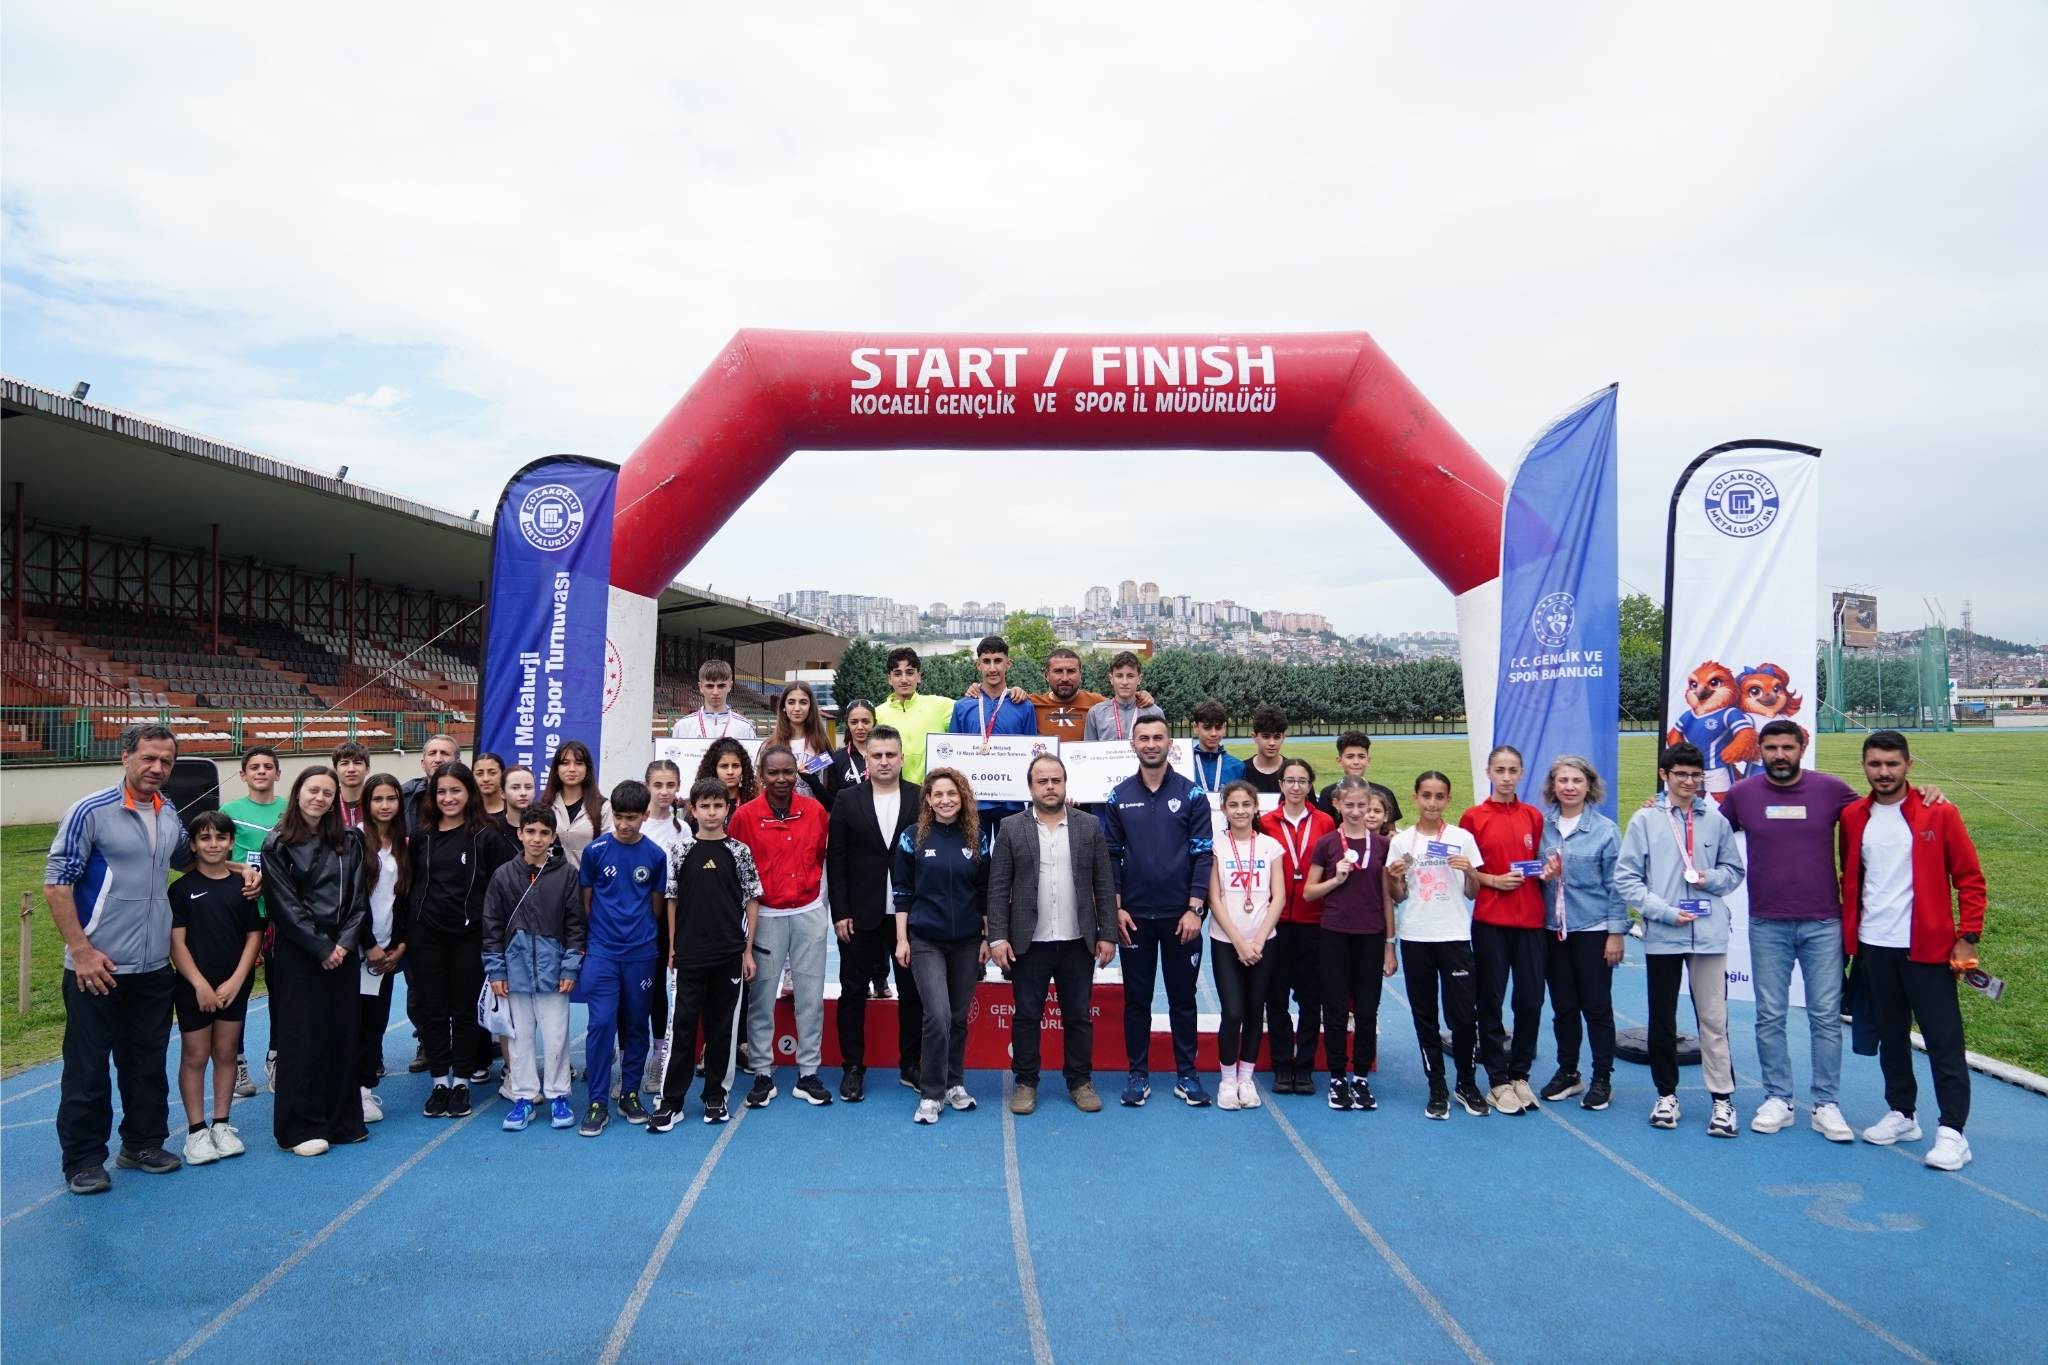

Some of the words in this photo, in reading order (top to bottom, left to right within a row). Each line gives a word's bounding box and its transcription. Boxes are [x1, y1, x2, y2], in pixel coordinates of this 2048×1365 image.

[850, 347, 1028, 389] START
[1092, 345, 1275, 386] FINISH
[850, 388, 930, 415] KOCAELİ
[935, 389, 1016, 418] GENÇLİK
[1033, 392, 1057, 413] VE
[1075, 391, 1127, 413] SPOR
[1132, 386, 1149, 413] İL
[1155, 386, 1277, 413] MÜDÜRLÜĞÜ
[1711, 473, 1773, 497] ÇOLAKOĞLU
[525, 487, 579, 511] ÇOLAKOĞLU
[545, 571, 571, 674] Turnuvası
[1584, 650, 1603, 663] VE
[1509, 670, 1539, 683] SPOR
[1541, 663, 1604, 681] BAANLIĞI
[515, 651, 541, 746] Metalurji
[542, 677, 566, 729] Spor
[545, 733, 561, 760] ve
[971, 773, 1013, 782] 6.000TL
[998, 1015, 1009, 1029] İL
[783, 1039, 792, 1051] 2
